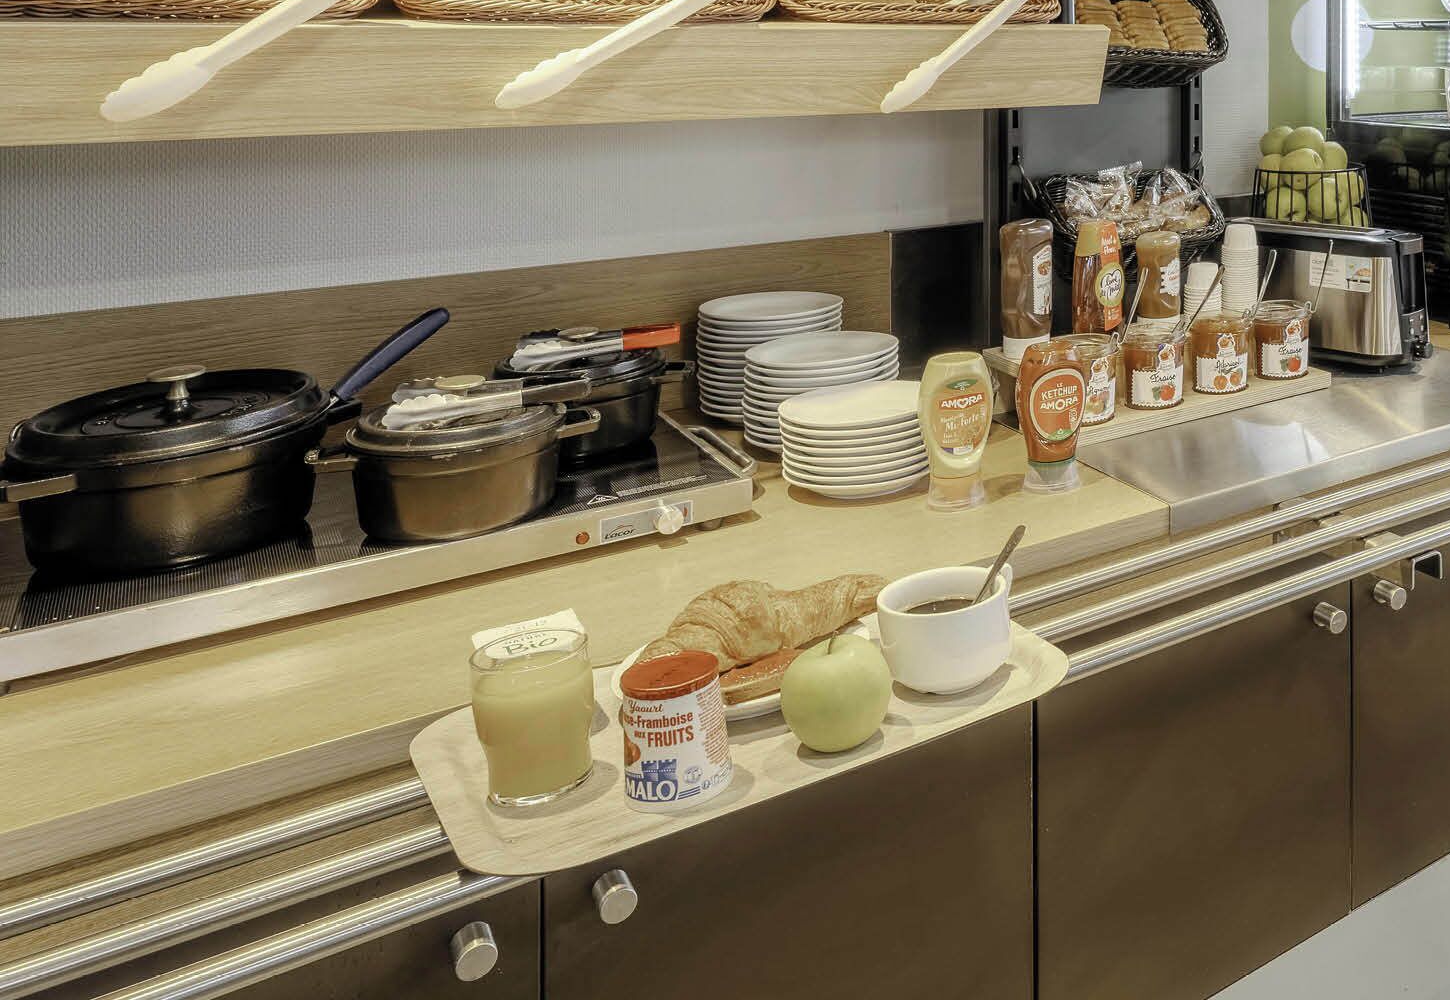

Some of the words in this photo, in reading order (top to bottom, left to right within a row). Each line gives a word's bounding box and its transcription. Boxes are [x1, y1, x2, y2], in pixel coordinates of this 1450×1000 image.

[1279, 344, 1303, 356] Fraise
[1150, 371, 1176, 383] Fraise
[1041, 385, 1078, 400] KETCHUP
[941, 393, 983, 409] AMORA
[1040, 396, 1078, 411] AMORA
[628, 699, 664, 714] Yaourt
[647, 725, 695, 748] FRUITS
[626, 776, 676, 801] MALO
